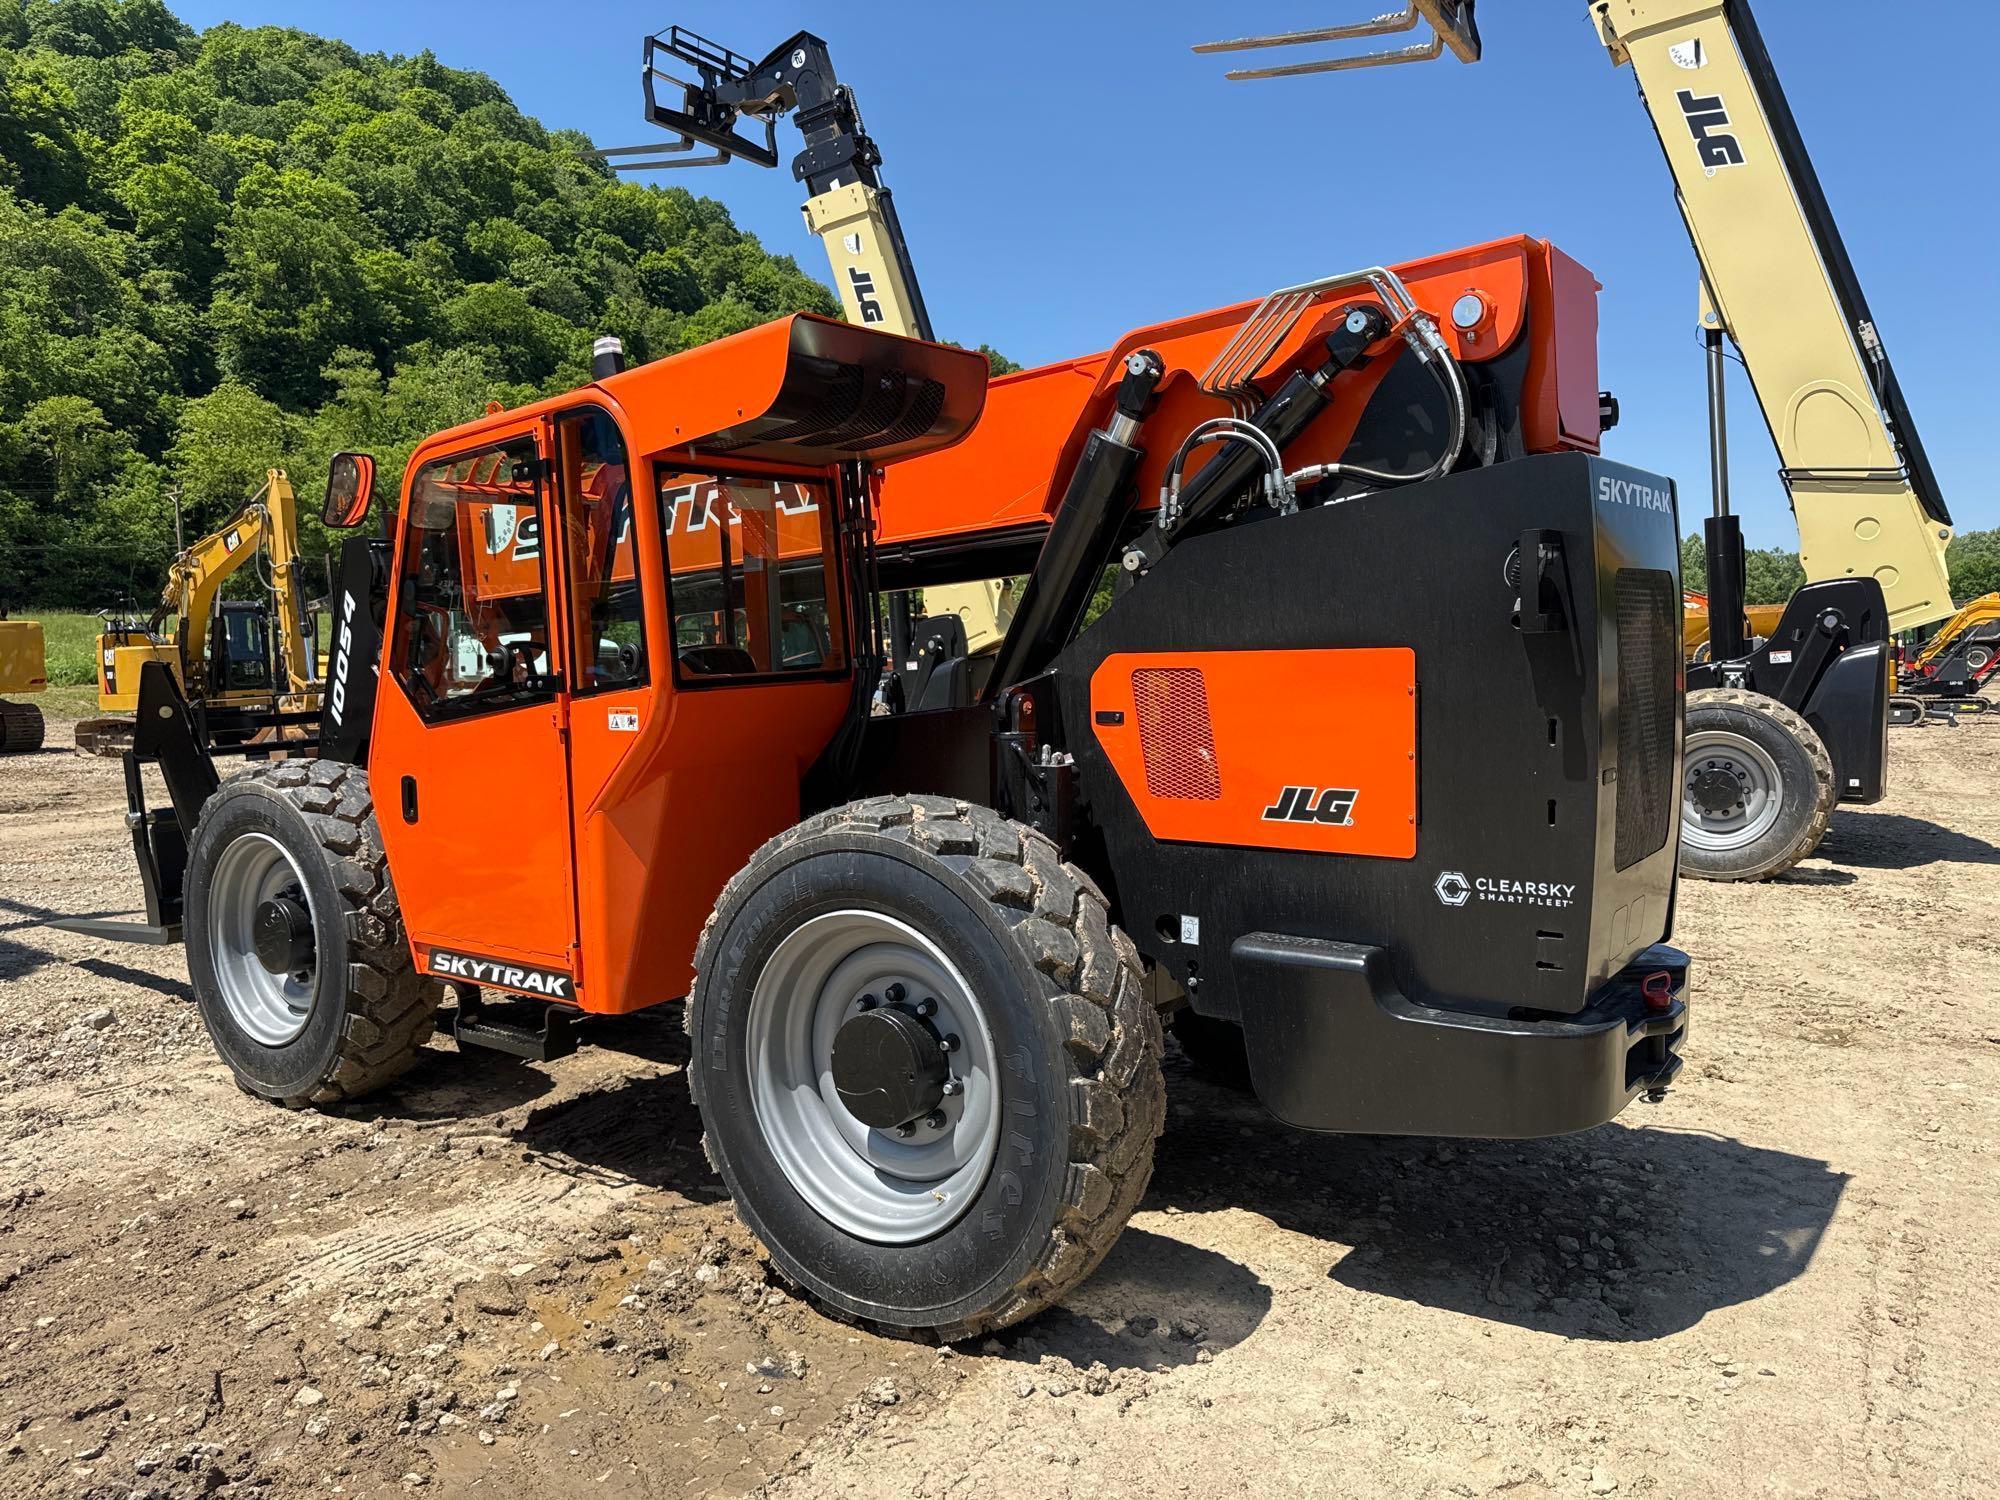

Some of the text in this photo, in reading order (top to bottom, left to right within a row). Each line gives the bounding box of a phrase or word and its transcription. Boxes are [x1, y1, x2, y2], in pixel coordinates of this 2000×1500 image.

[1674, 88, 1748, 168] JLG
[847, 265, 885, 324] JLG
[1598, 476, 1671, 514] SKYTRAK
[331, 589, 356, 726] 10054
[1261, 785, 1360, 826] JLG
[1475, 877, 1576, 898] CLEARSKY
[1479, 892, 1523, 904] SMART
[433, 952, 568, 997] SKYTRAK
